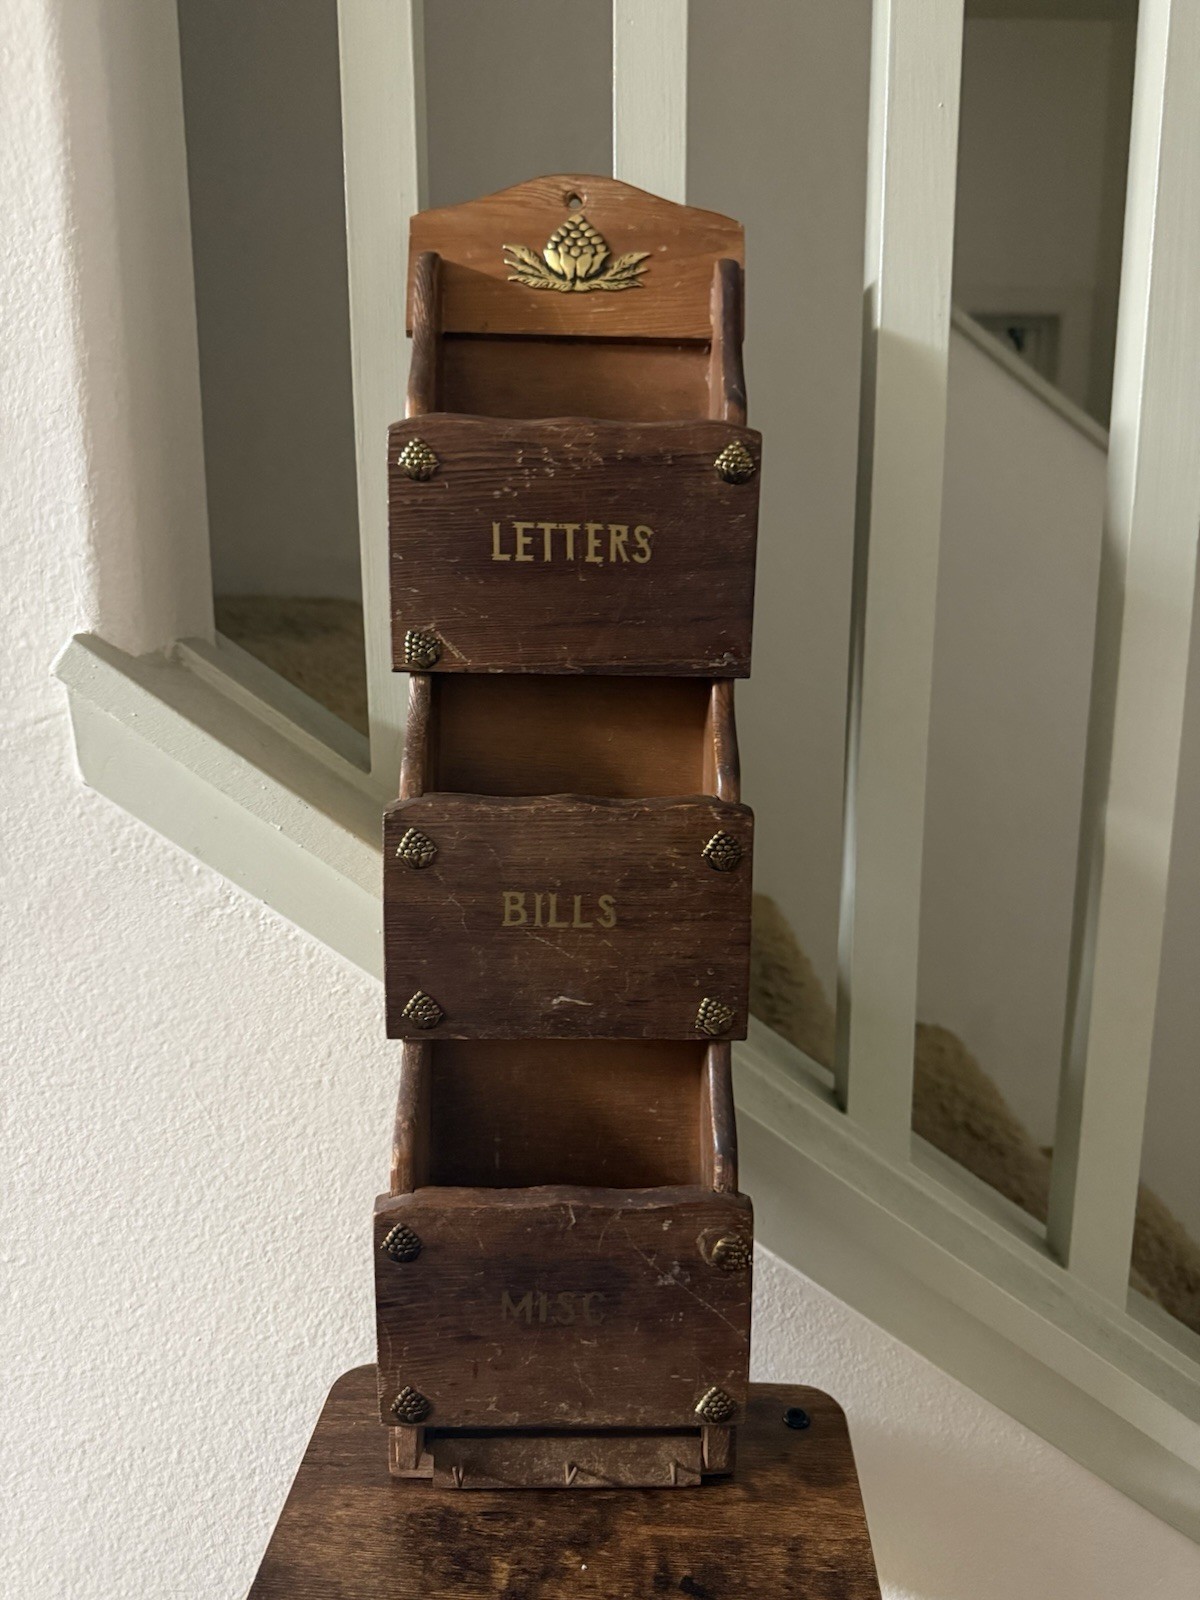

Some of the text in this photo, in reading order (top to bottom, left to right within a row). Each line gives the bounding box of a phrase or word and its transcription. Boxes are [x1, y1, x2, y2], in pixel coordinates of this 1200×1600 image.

[491, 521, 654, 564] LETTERS
[501, 891, 617, 928] BILLS
[501, 1290, 607, 1326] MISC
